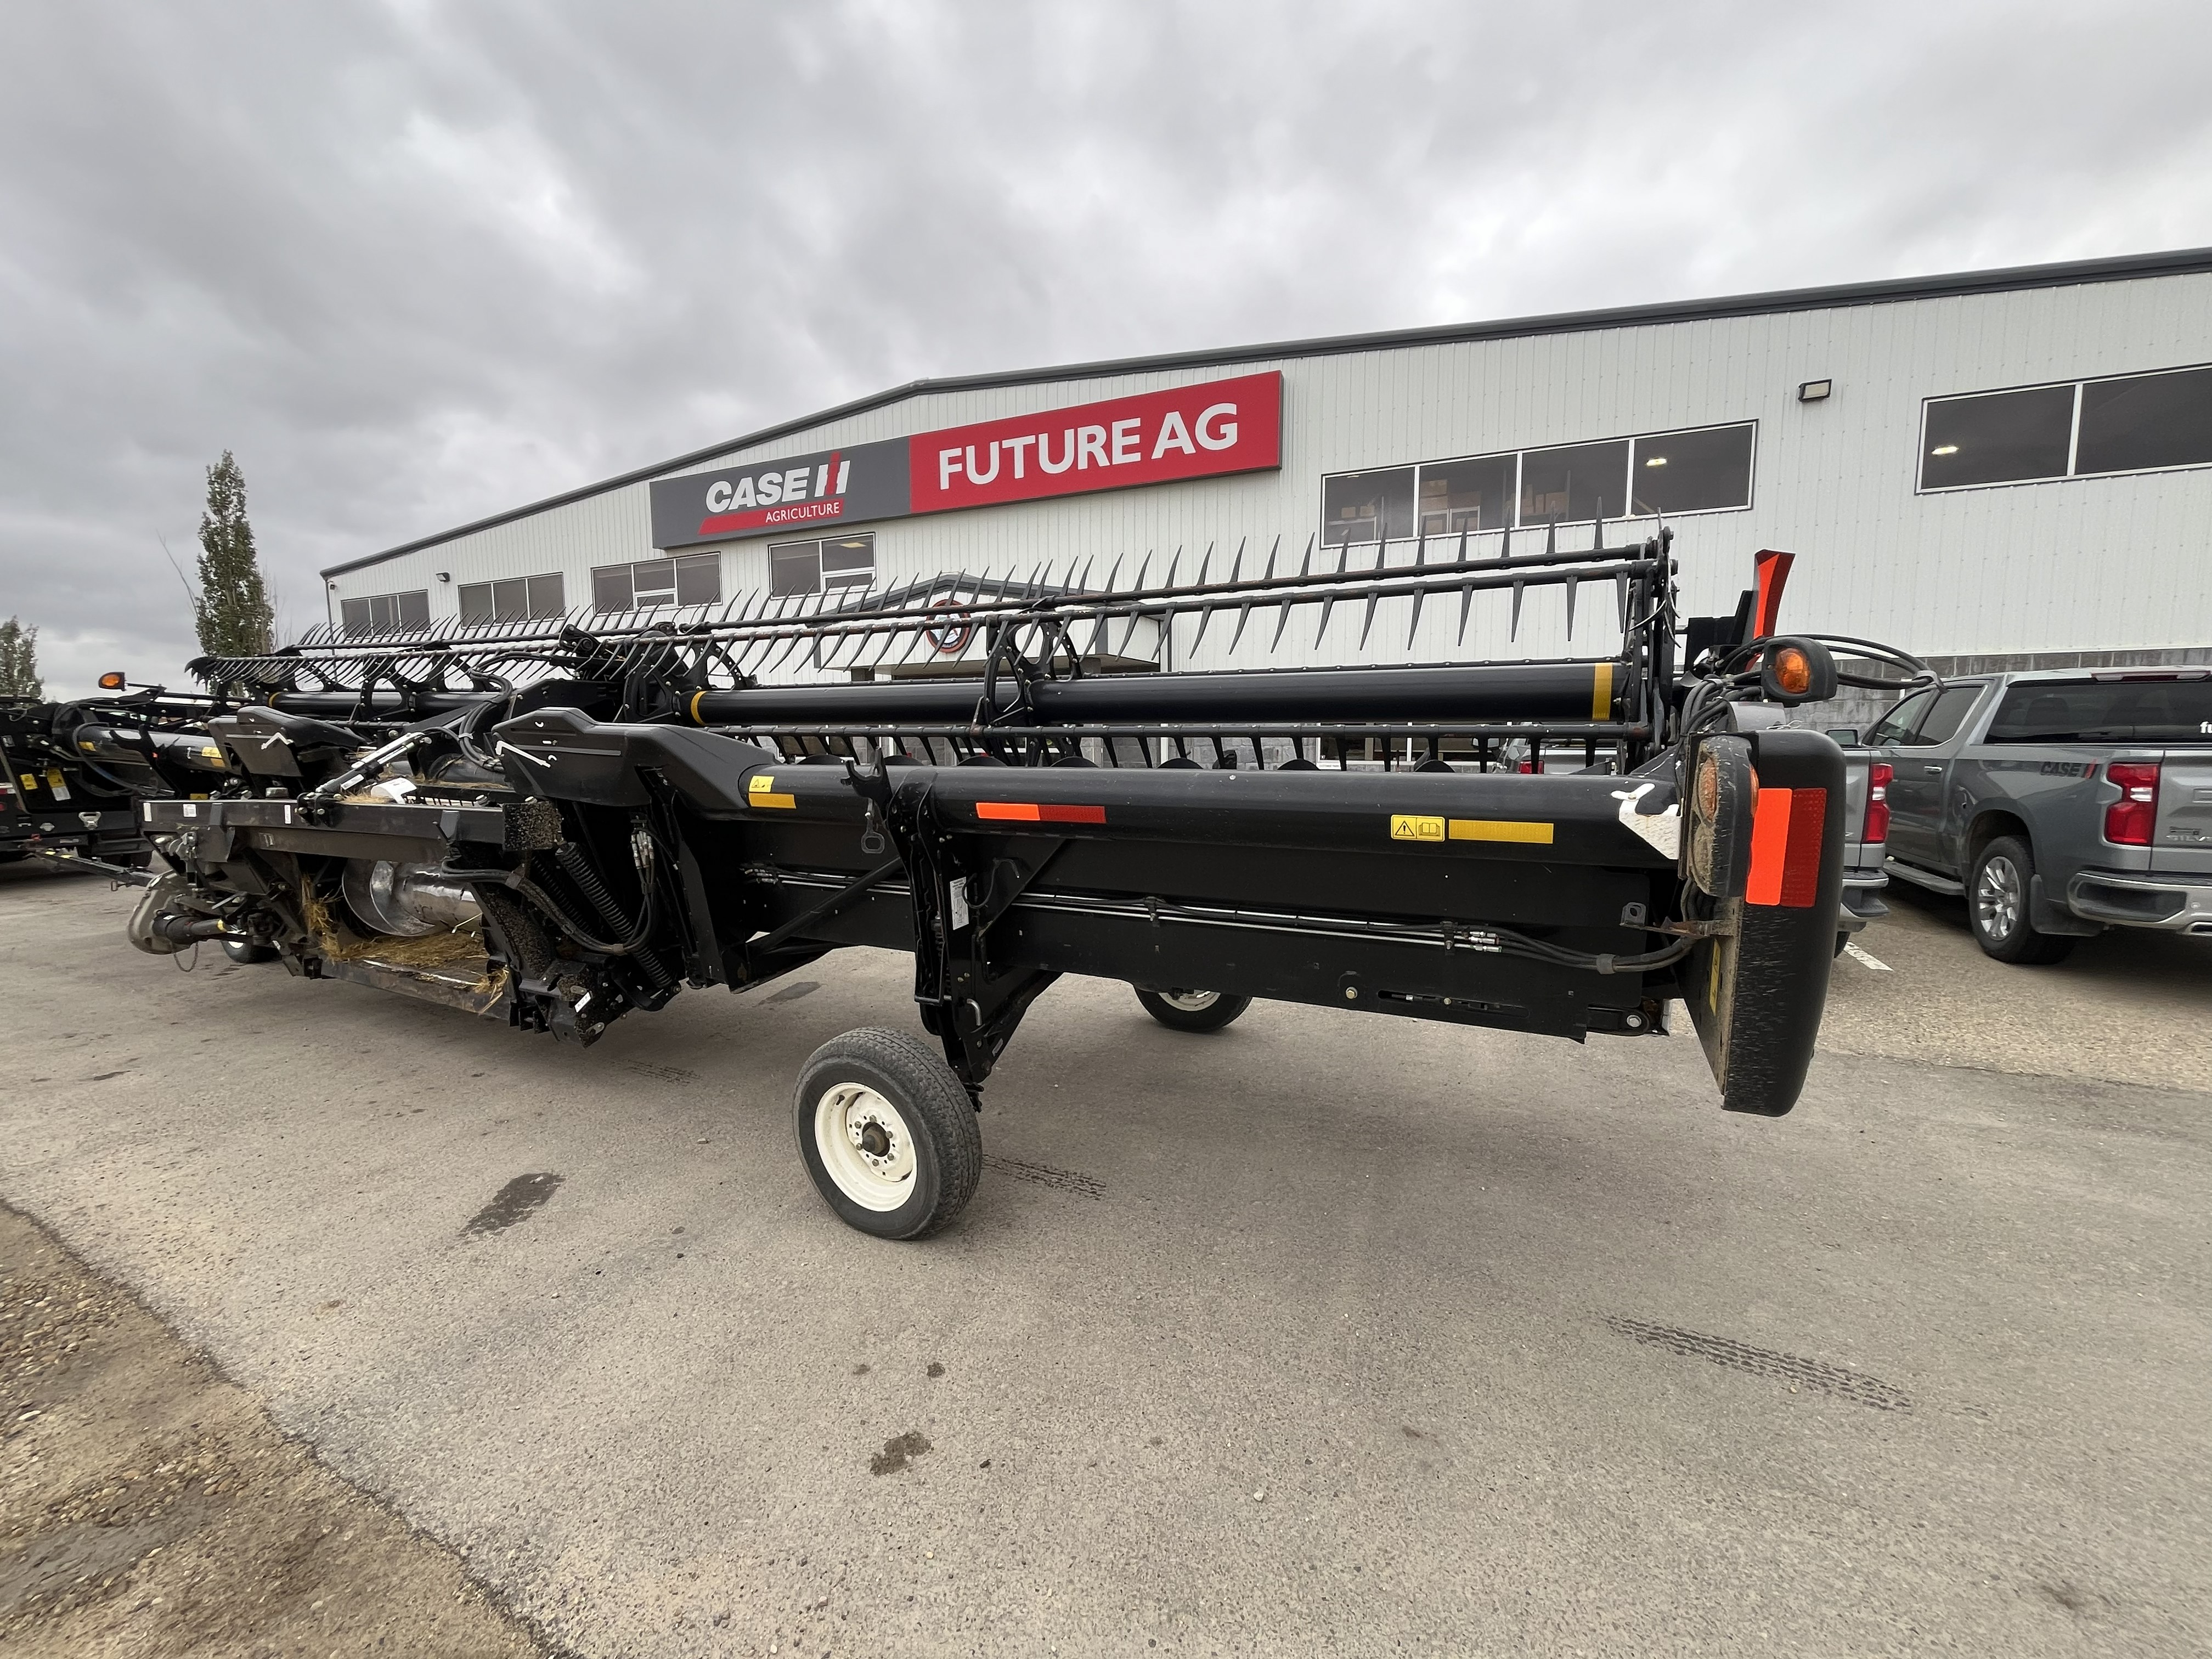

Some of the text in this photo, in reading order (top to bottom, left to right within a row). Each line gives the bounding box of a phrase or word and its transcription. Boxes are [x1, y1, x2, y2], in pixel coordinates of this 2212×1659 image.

[939, 403, 1238, 490] FUTURE AG
[706, 466, 810, 513] CASE
[765, 501, 840, 523] AGRICULTURE
[2040, 761, 2081, 777] CASE
